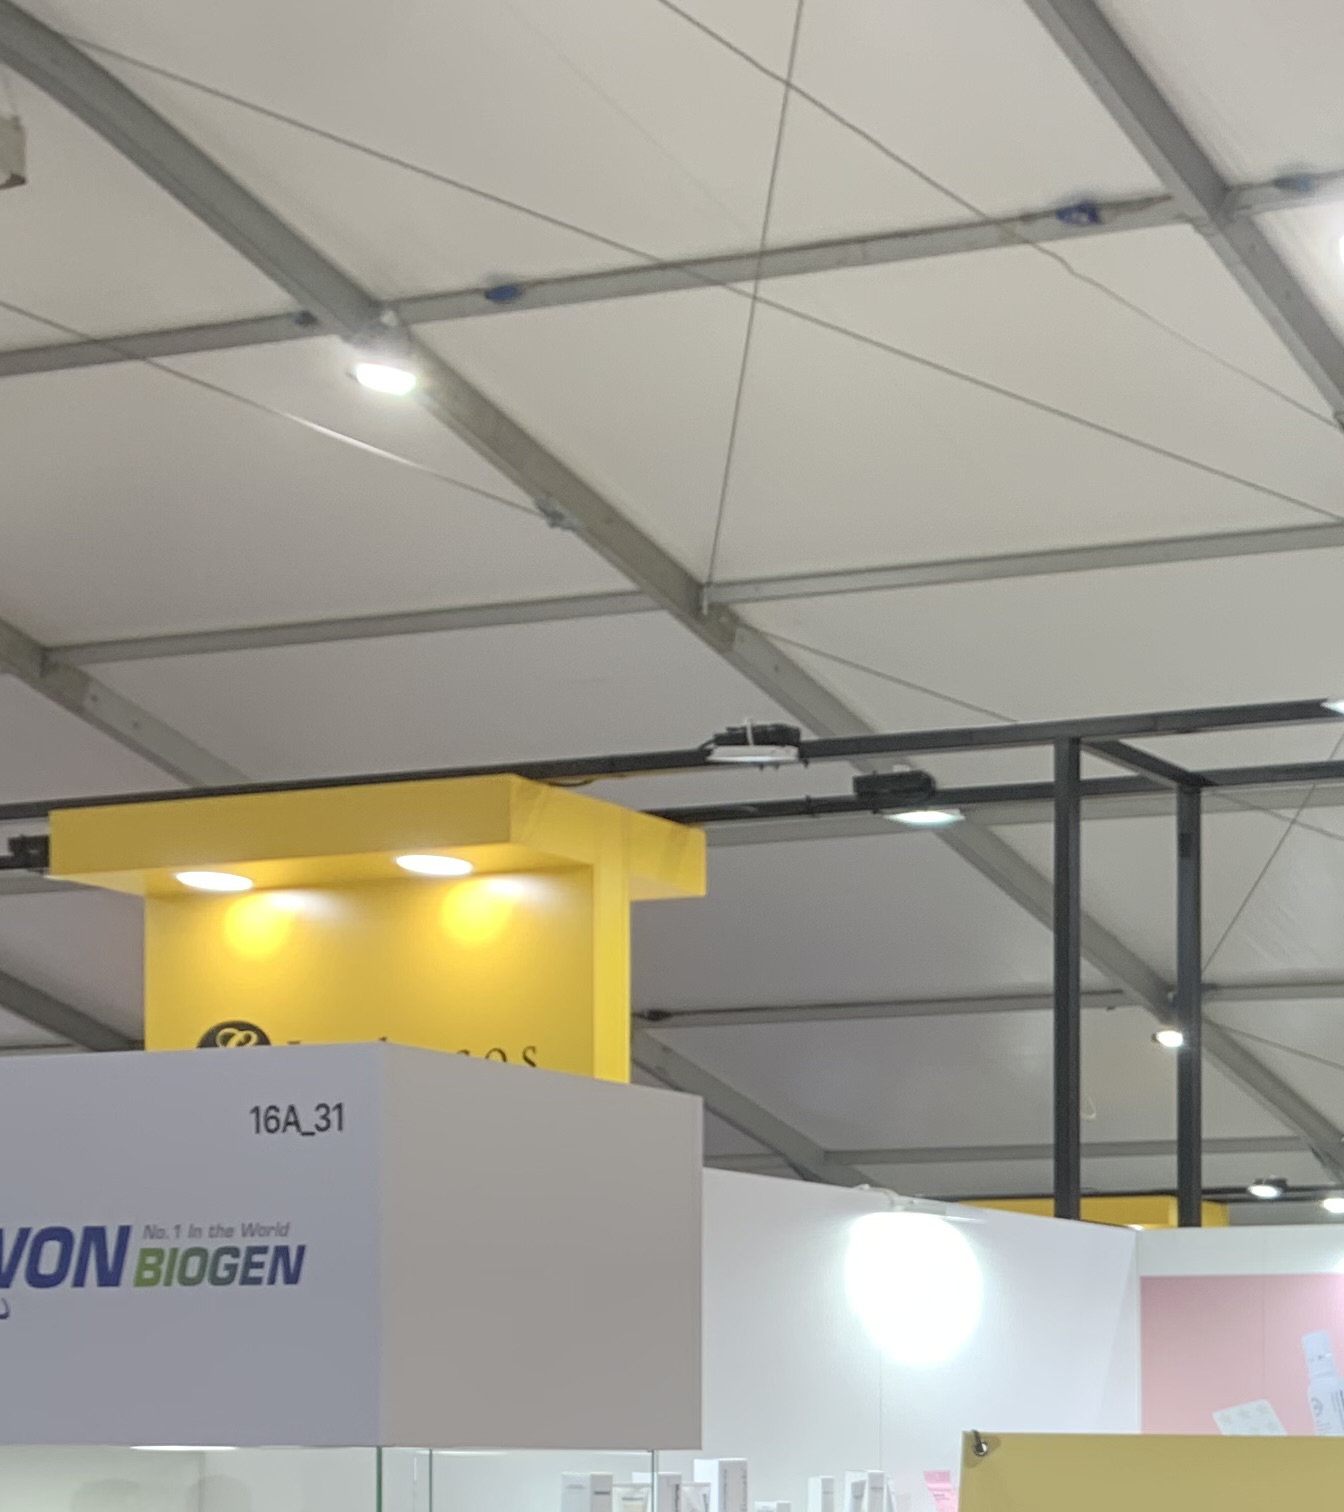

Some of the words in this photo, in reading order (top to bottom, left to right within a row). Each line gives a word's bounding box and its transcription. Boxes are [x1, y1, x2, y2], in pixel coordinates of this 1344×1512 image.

[250, 1102, 345, 1136] 16A_31
[208, 1223, 234, 1239] the
[241, 1221, 291, 1238] World
[133, 1244, 307, 1288] BIOGEN
